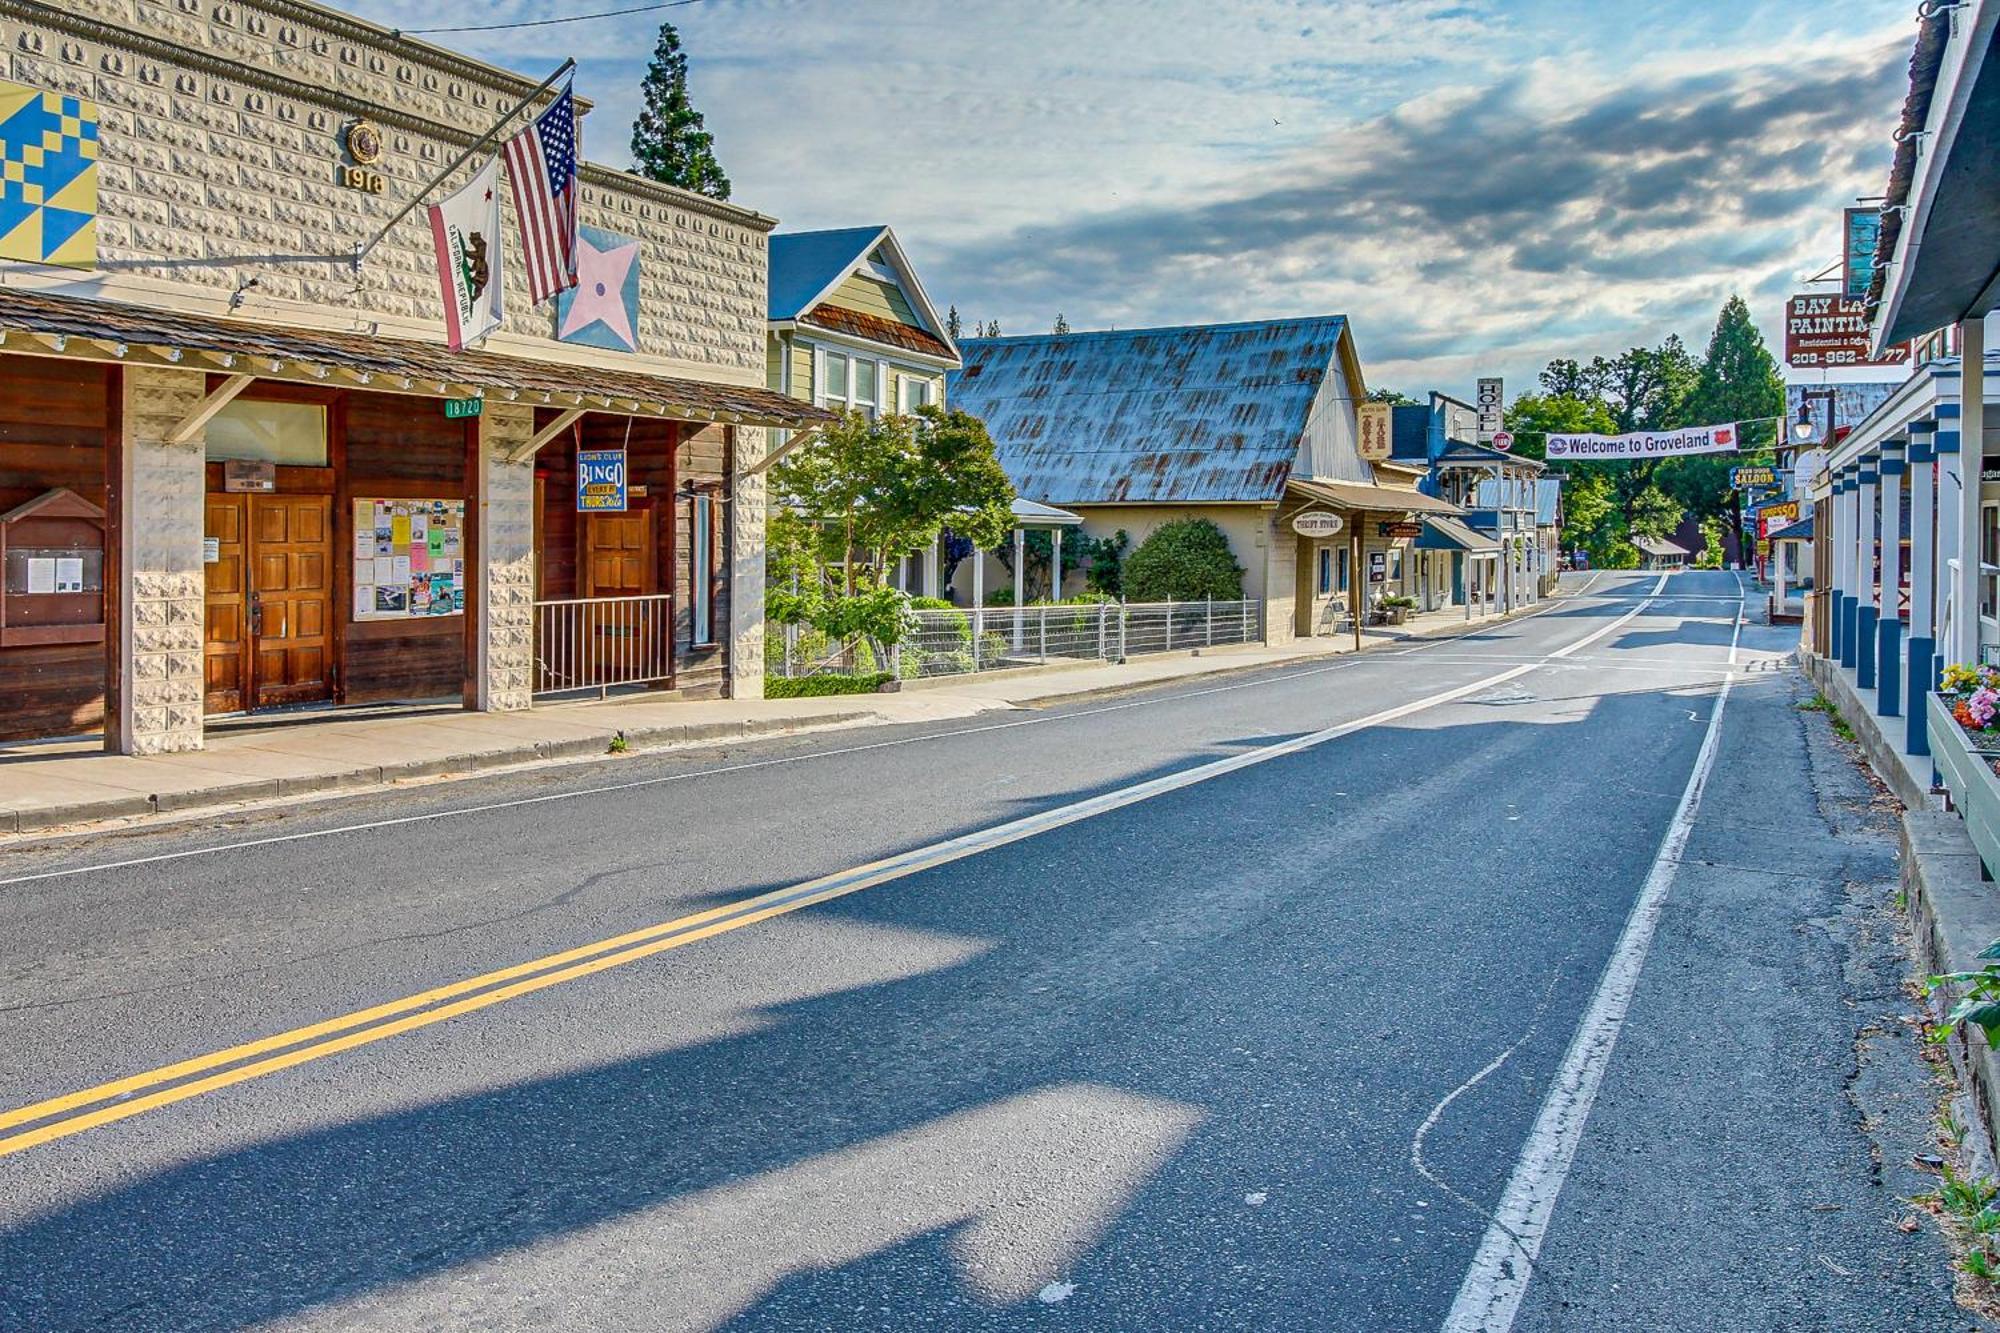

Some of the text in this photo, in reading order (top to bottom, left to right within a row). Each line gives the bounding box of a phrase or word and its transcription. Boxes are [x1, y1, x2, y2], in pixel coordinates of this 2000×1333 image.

[345, 169, 385, 193] 1918
[1793, 298, 1832, 315] BAY
[449, 399, 480, 416] 18720
[1479, 385, 1497, 433] HOTEL
[1569, 431, 1710, 454] Welcome to Groveland
[579, 462, 624, 492] BINGO
[1735, 473, 1774, 485] SALOON
